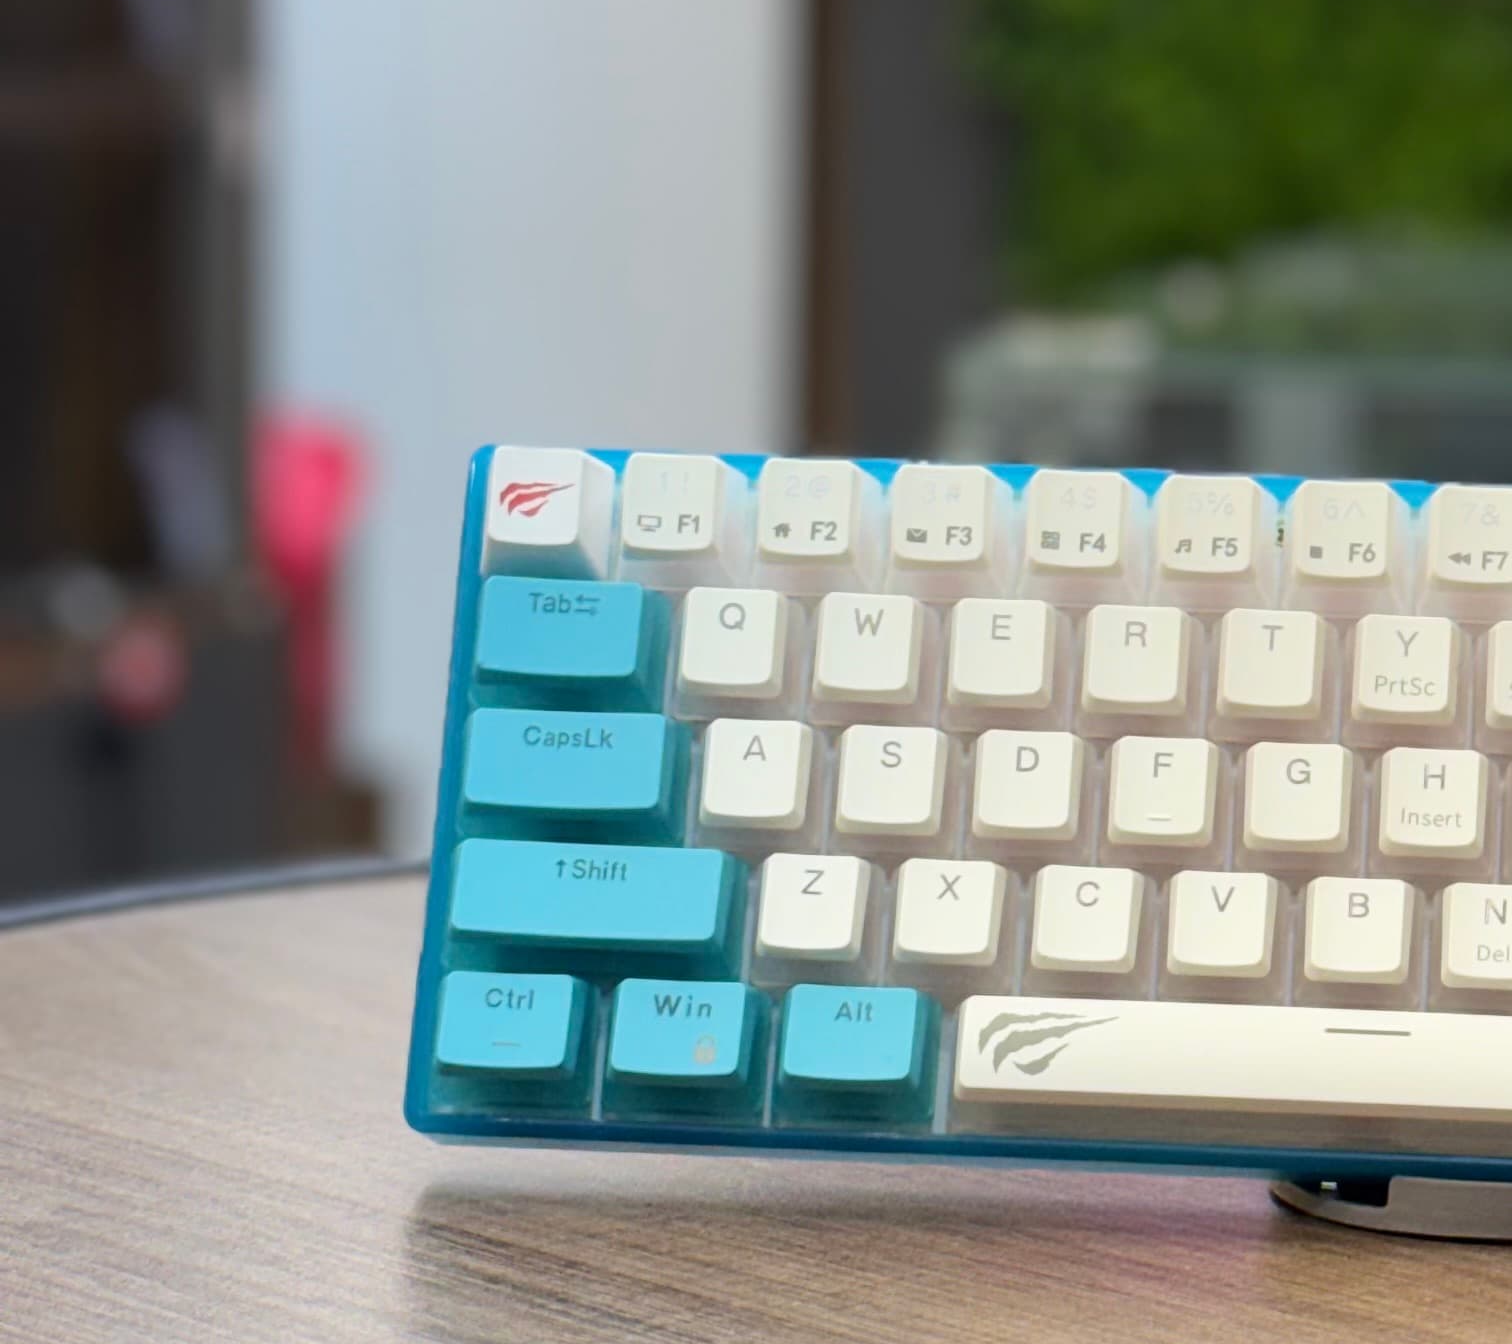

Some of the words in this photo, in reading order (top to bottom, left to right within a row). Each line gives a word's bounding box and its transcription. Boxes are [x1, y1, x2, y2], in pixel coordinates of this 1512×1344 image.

[677, 513, 700, 535] F1
[810, 521, 838, 542] F2
[945, 525, 973, 547] F3
[1079, 532, 1107, 554] F4
[1211, 536, 1239, 558] F5
[1348, 542, 1377, 564] F6
[1481, 550, 1509, 572] F7
[530, 591, 571, 615] Tab
[719, 602, 746, 631] Q
[854, 608, 885, 636] W
[991, 614, 1013, 641] E
[1125, 621, 1148, 648] R
[1262, 625, 1284, 651] T
[1396, 630, 1419, 656] Y
[1374, 675, 1437, 697] PrtSc
[523, 725, 613, 752] CapsLk
[742, 735, 767, 762] A
[880, 742, 902, 768] S
[1016, 746, 1040, 772] D
[1154, 752, 1174, 778] F
[1286, 759, 1311, 785] G
[1423, 764, 1446, 791] H
[1401, 808, 1463, 829] Insert
[571, 858, 628, 881] Shift
[801, 870, 825, 895] Z
[937, 874, 961, 900] X
[1076, 881, 1100, 907] C
[1211, 886, 1235, 912] V
[1348, 893, 1370, 918] B
[1484, 898, 1507, 925] N
[1476, 945, 1510, 963] Del
[485, 988, 534, 1010] Ctrl
[654, 994, 712, 1018] Win
[834, 1002, 873, 1023] Alt
